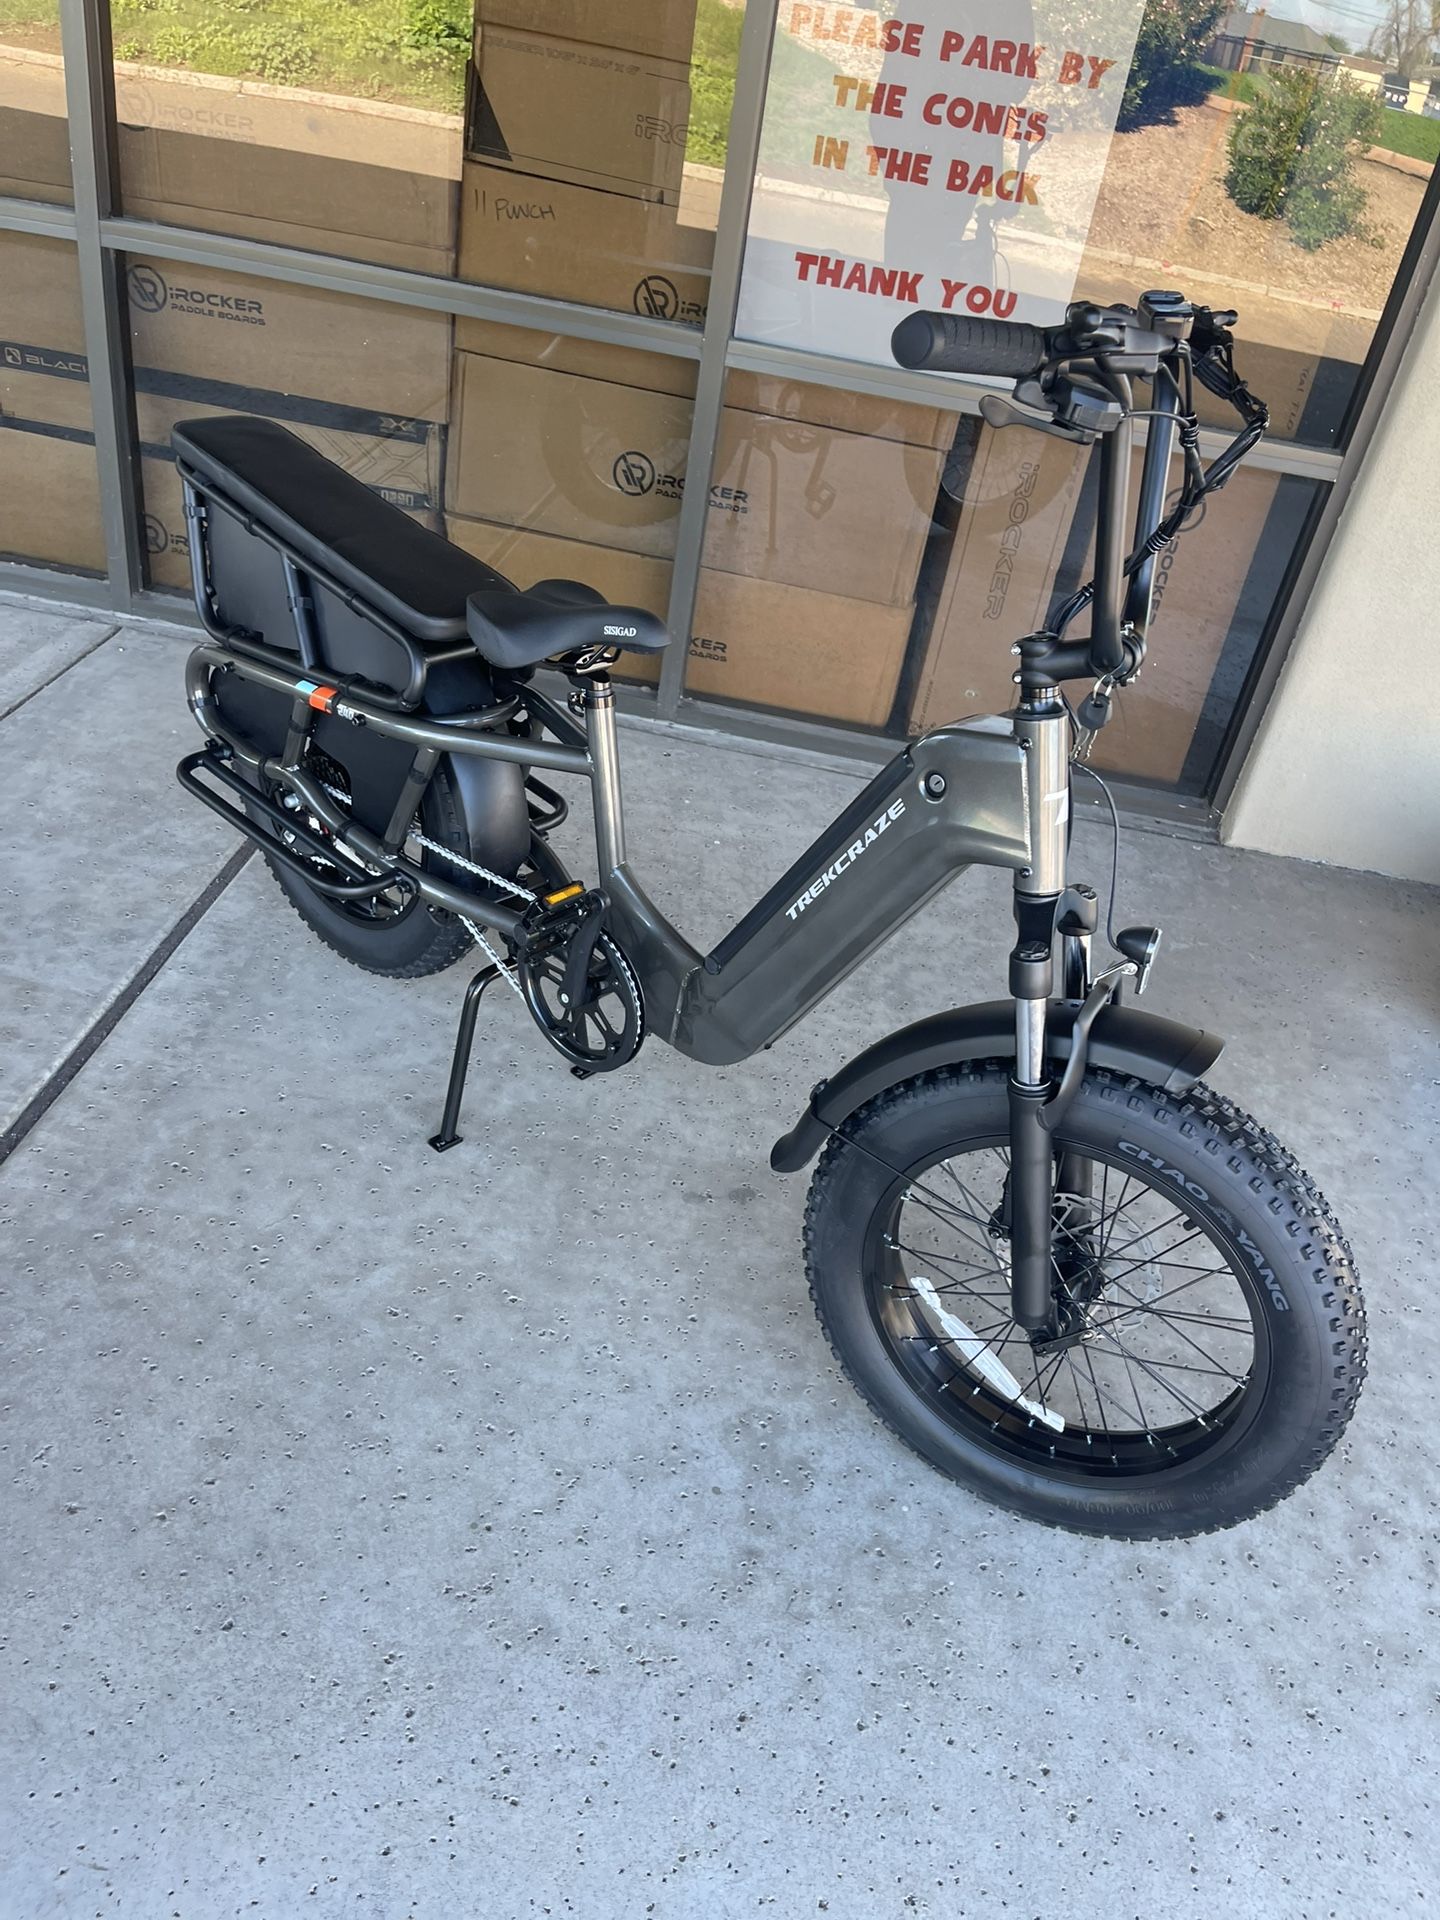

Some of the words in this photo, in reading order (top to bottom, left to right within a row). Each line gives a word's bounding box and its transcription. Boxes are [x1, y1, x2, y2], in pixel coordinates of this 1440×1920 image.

[789, 4, 925, 57] PLEASE
[939, 30, 1046, 80] PARK
[1058, 51, 1118, 89] BY
[833, 75, 907, 119] THE
[923, 93, 1049, 143] CONES
[812, 135, 849, 170] IN
[866, 145, 932, 186] THE
[946, 159, 1041, 206] BACK
[495, 198, 556, 221] PUNCH
[169, 287, 263, 314] iROCKER
[171, 303, 215, 317] PADDLE
[217, 311, 266, 326] BOARDS
[795, 252, 924, 304] THANK
[941, 278, 1018, 319] YOU
[708, 499, 749, 514] OARDS
[982, 461, 1040, 620] iROCKER
[603, 625, 637, 637] SISIGAD
[689, 650, 728, 662] OARDS
[785, 798, 906, 920] TREKCRAZE
[1117, 1141, 1209, 1201] CHAO
[1236, 1229, 1290, 1311] YANG
